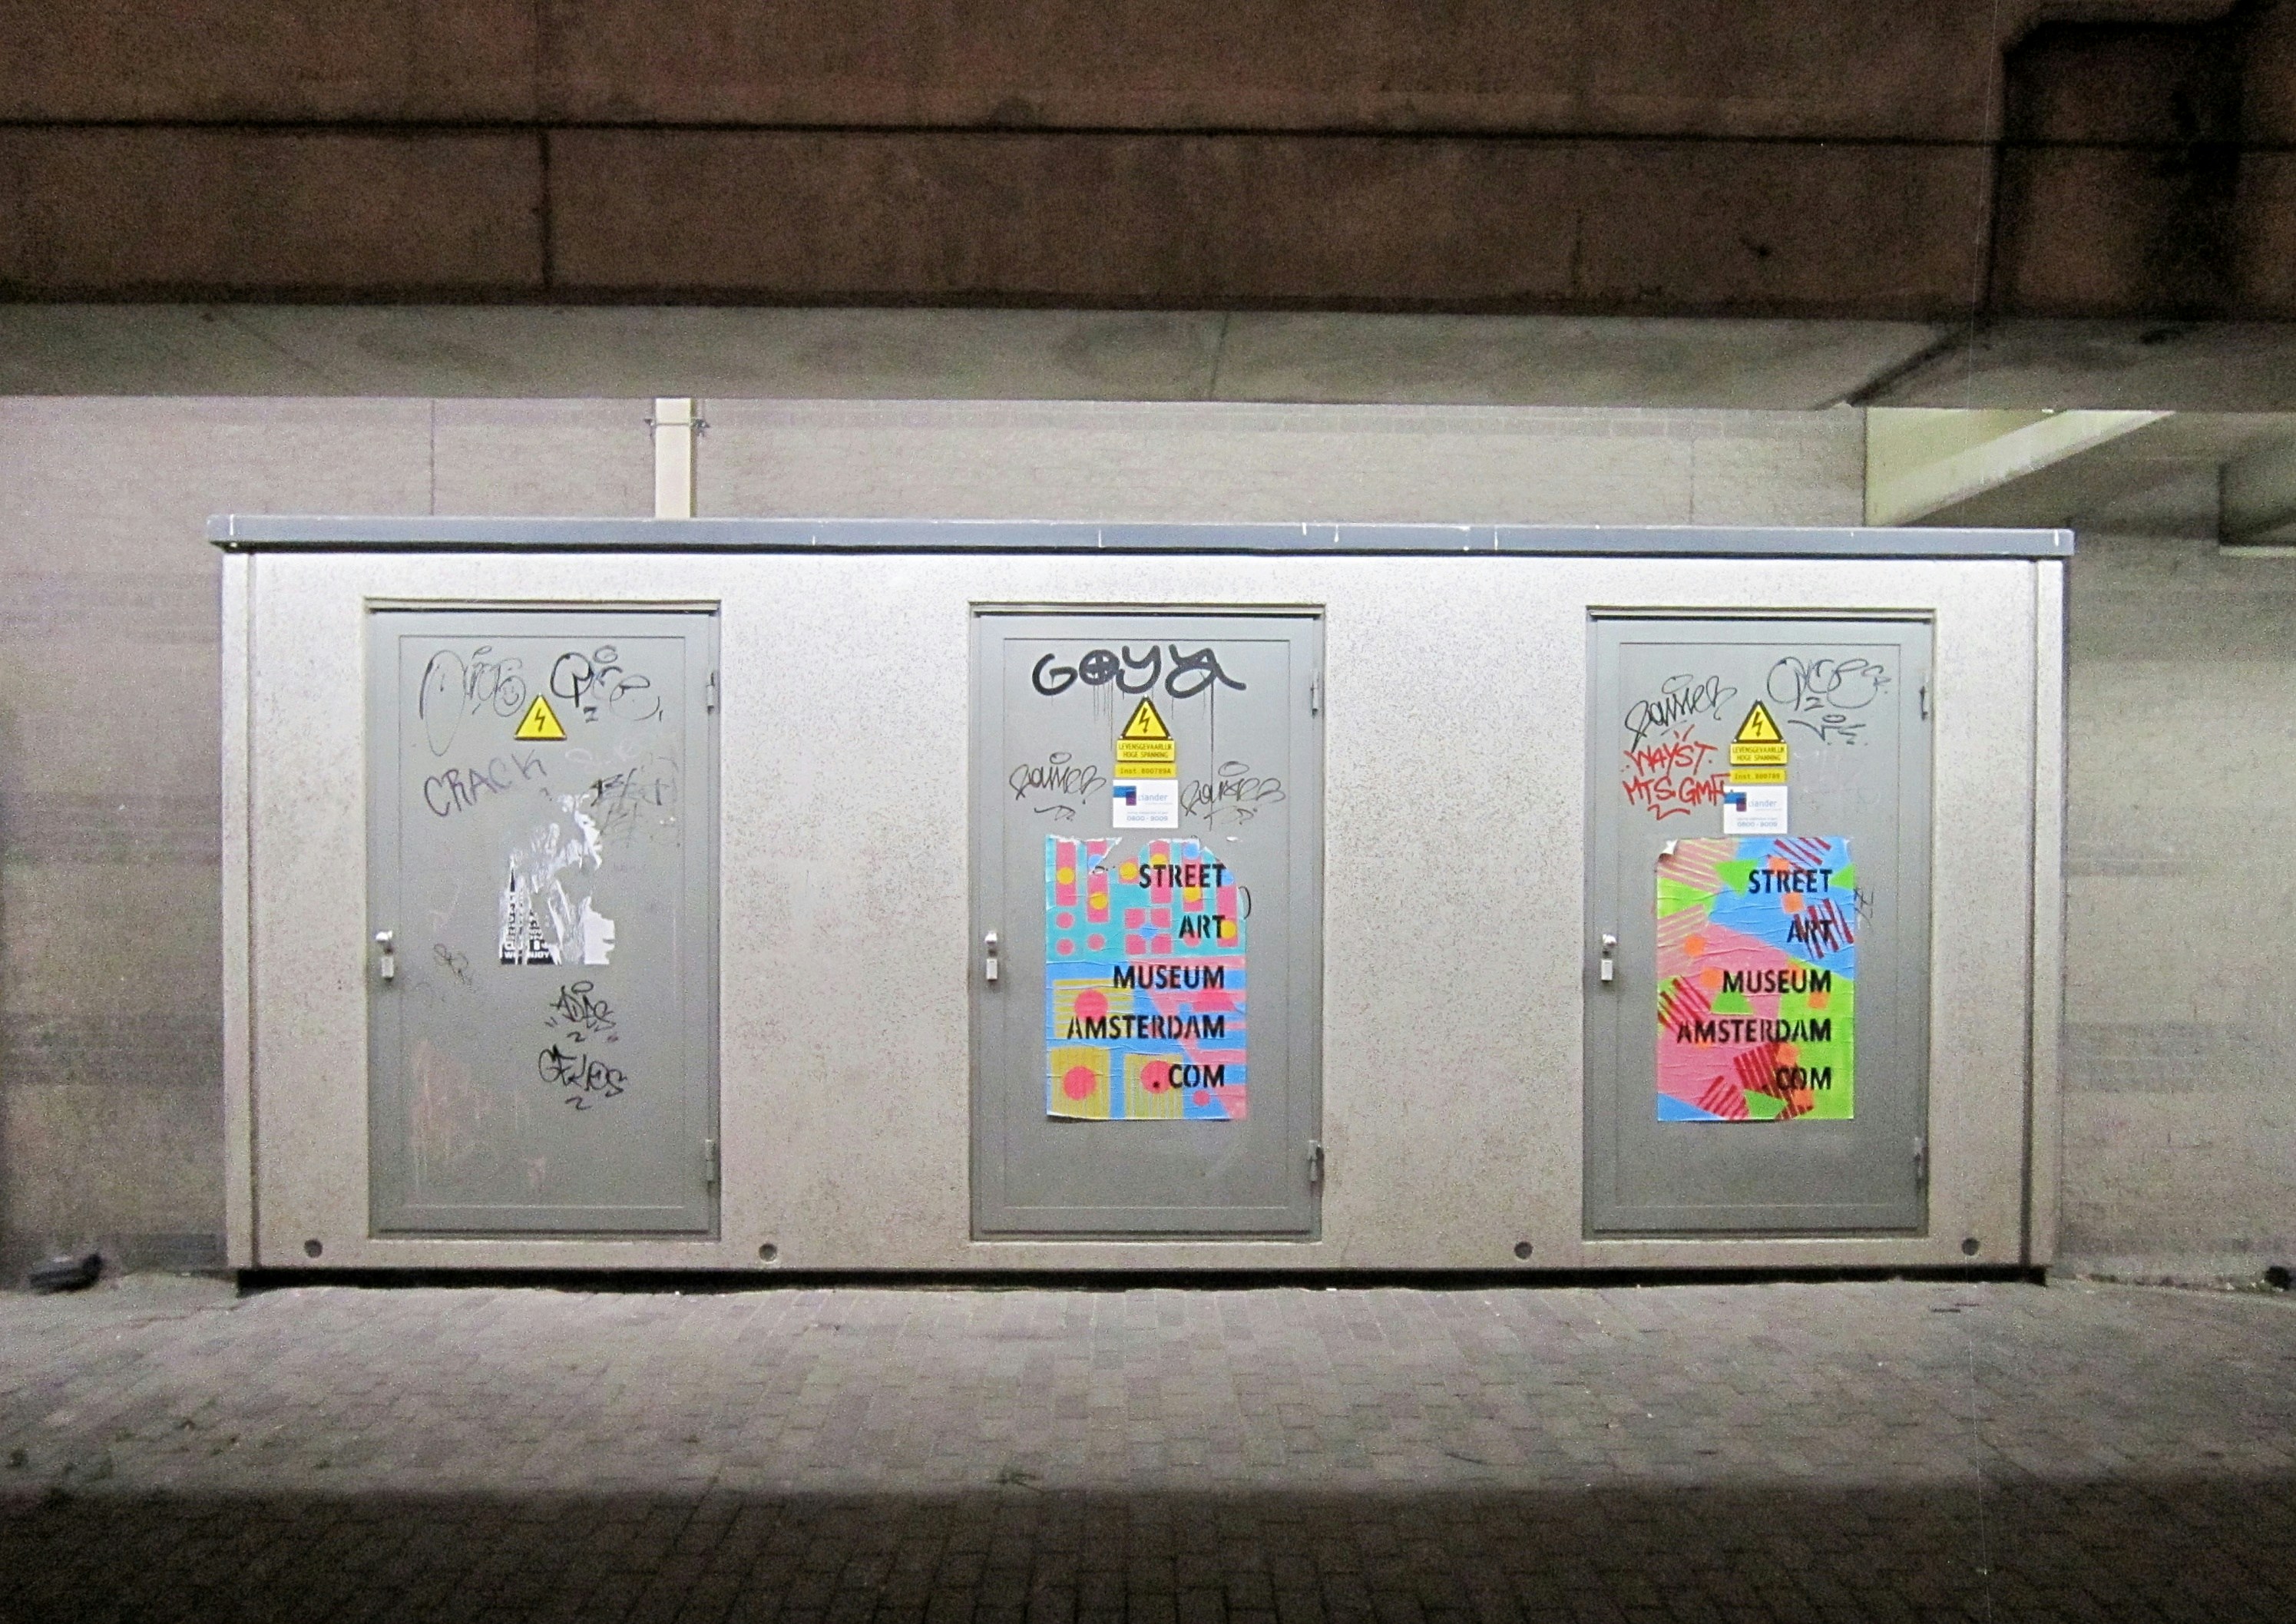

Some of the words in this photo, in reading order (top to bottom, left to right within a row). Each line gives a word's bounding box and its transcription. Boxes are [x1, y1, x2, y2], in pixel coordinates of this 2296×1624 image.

[1032, 644, 1247, 699] GOYA
[424, 749, 547, 817] CRACK
[1139, 864, 1226, 889] STREET
[1748, 868, 1833, 894] STREET
[1179, 915, 1226, 939] ART
[1787, 919, 1832, 943] ART
[1113, 965, 1225, 990] MUSEUM
[1722, 969, 1831, 994] MUSEUM
[1067, 1014, 1225, 1040] AMSTERDAM
[1677, 1018, 1831, 1044] AMSTERDAM
